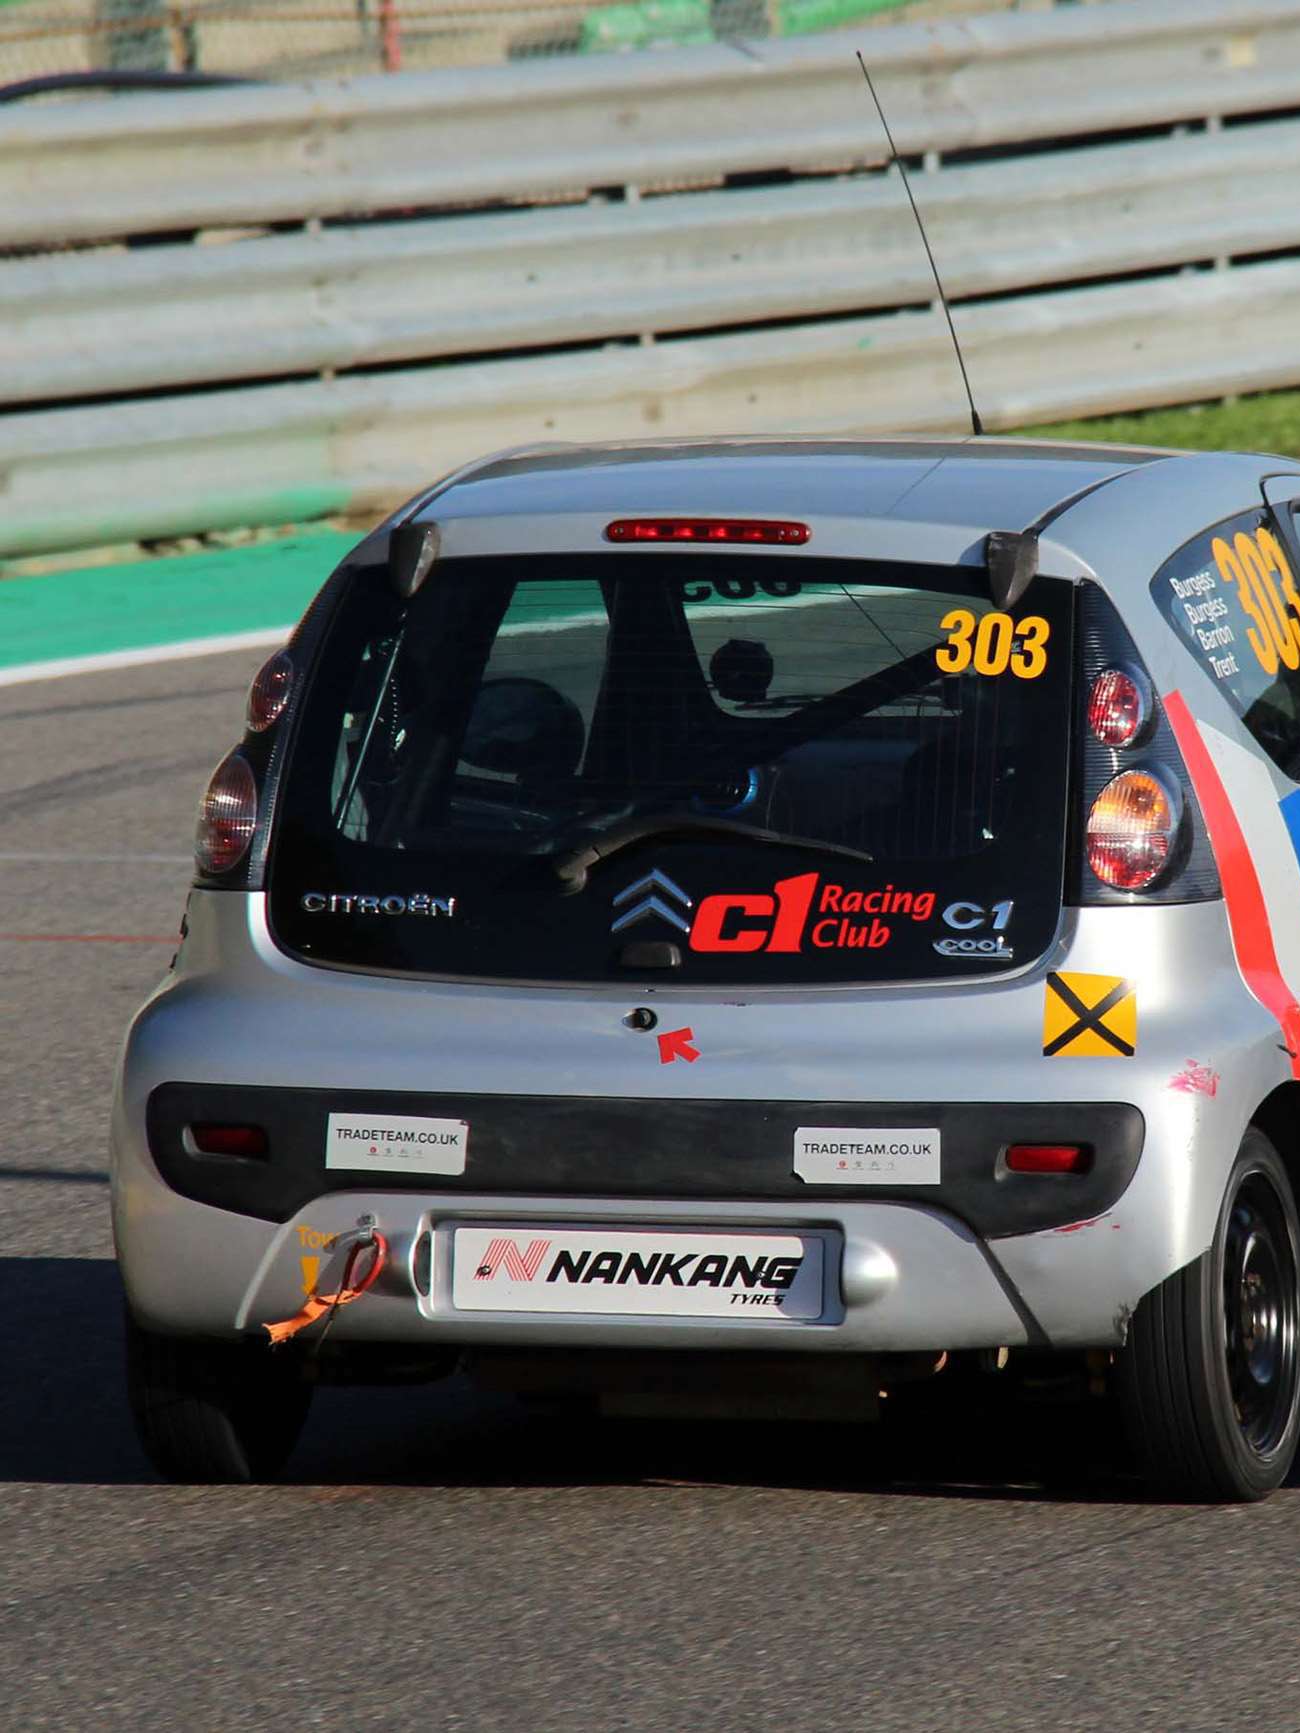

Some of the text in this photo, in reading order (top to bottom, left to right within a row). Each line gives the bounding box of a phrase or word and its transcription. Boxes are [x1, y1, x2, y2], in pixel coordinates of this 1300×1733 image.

[1169, 571, 1216, 599] Burgess
[1184, 597, 1228, 624] Burgess
[935, 609, 1050, 679] 303
[1196, 625, 1235, 651] Barron
[1209, 652, 1240, 679] Trent
[820, 885, 936, 921] Racing
[942, 900, 1014, 929] C1
[812, 919, 891, 948] Club
[336, 1128, 459, 1146] TRADETEAM.CO.UK
[803, 1143, 932, 1155] TRADETEAM.CO.UK
[546, 1249, 804, 1290] NANKANG
[730, 1293, 787, 1306] TYRES
